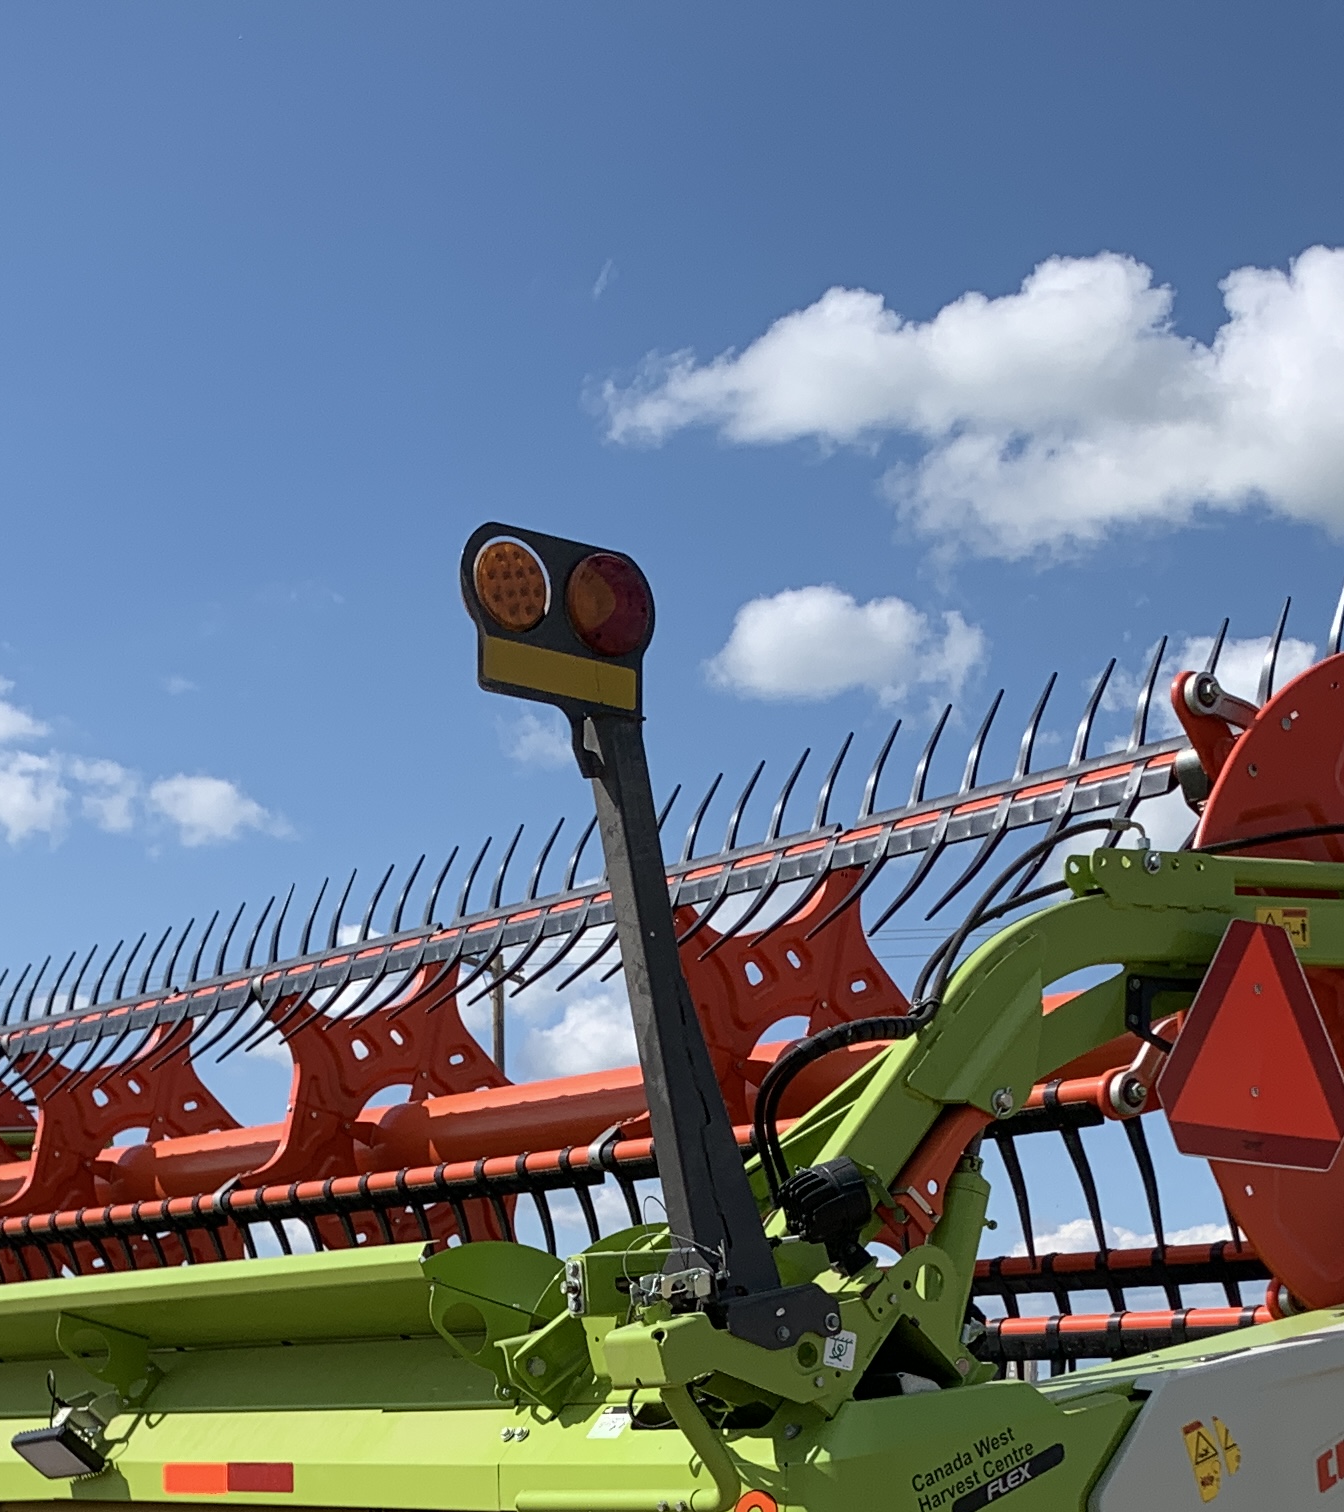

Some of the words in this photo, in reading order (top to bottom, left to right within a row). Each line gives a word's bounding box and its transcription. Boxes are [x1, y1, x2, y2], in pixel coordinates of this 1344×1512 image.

[912, 1452, 973, 1492] Canada
[973, 1427, 1015, 1458] West
[982, 1442, 1033, 1478] Centre
[987, 1462, 1032, 1500] FLEX
